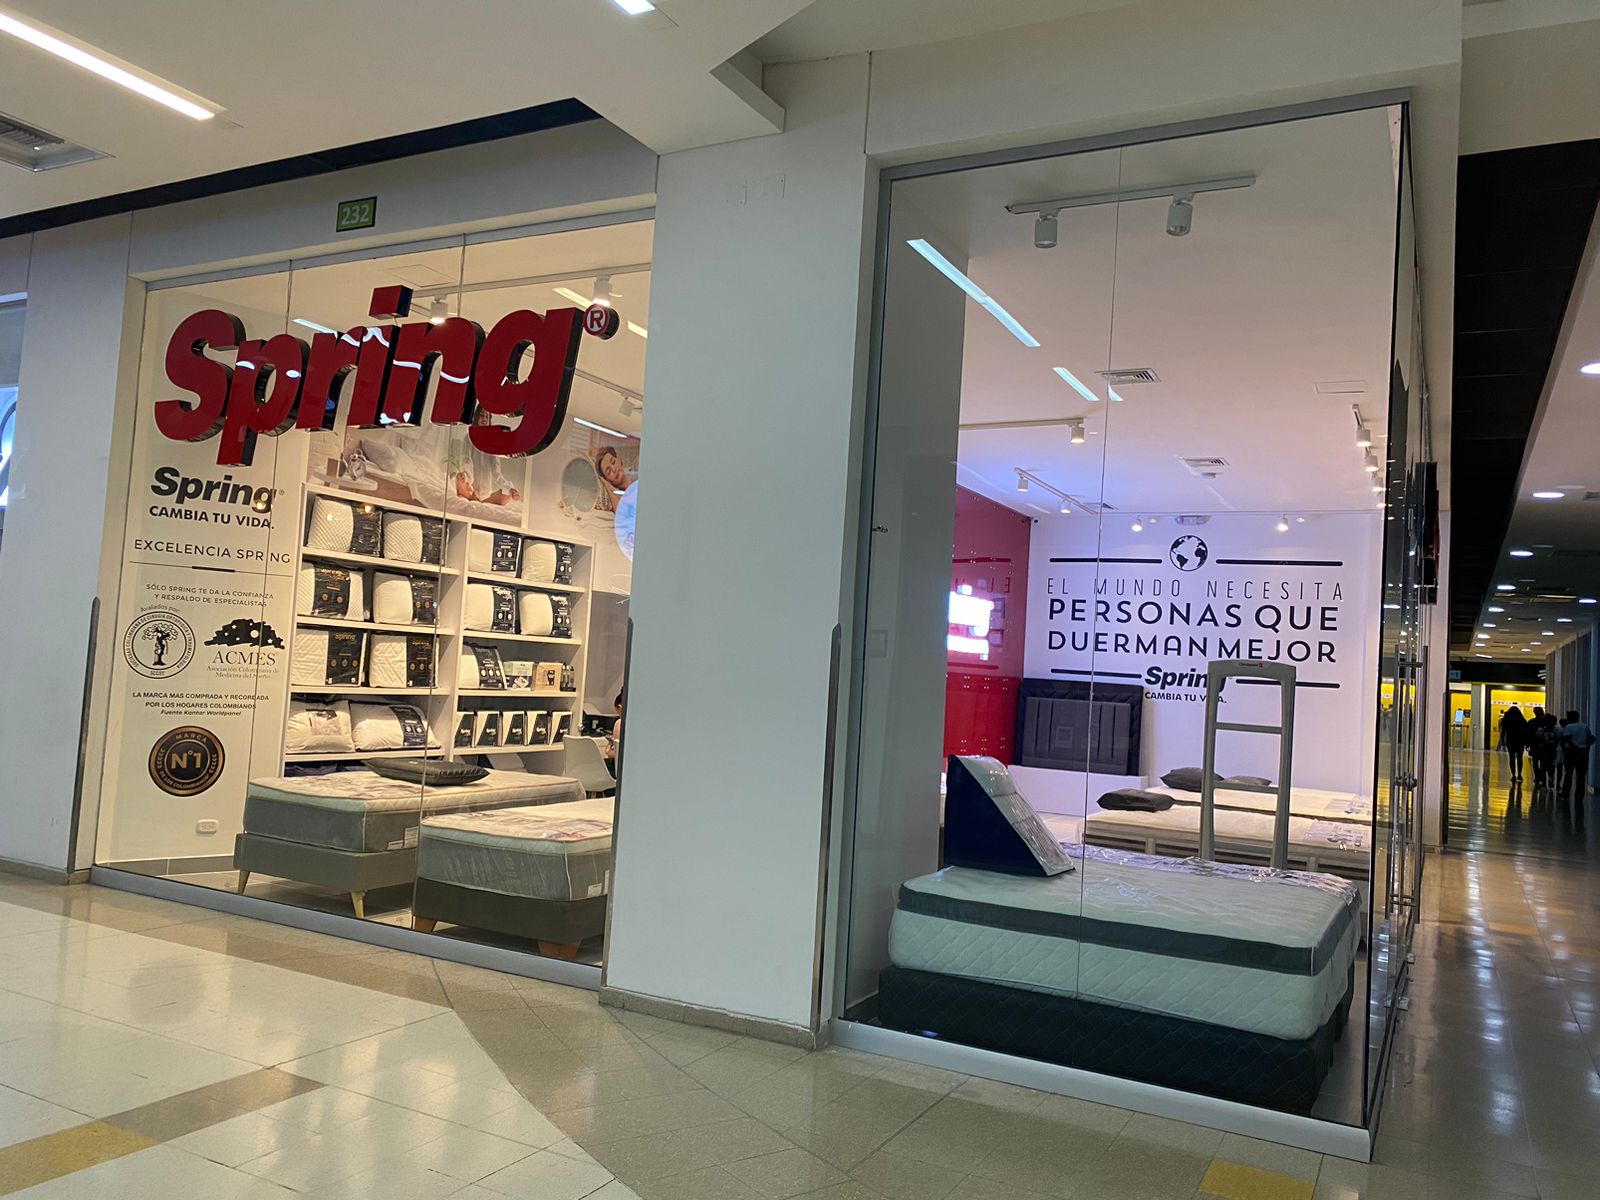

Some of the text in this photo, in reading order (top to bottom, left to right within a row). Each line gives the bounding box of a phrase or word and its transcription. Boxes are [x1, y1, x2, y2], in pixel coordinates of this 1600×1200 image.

[341, 204, 369, 225] 232
[151, 467, 276, 513] Spring
[149, 505, 274, 529] CAMBIA TU VIDA.
[134, 539, 290, 563] EXCELENCIA SPRNG
[169, 585, 197, 594] SPRING
[232, 590, 274, 600] CONFIANZA
[1047, 577, 1343, 601] EL MUNDO NECESITA
[161, 594, 201, 602] RESPALDO
[214, 597, 267, 608] ESPECIALISTAS
[1049, 598, 1339, 634] PERSONAS QUE
[1048, 630, 1336, 663] DUERMAN MEJOR
[212, 651, 276, 666] ACMES
[1144, 691, 1182, 701] CAMBIA
[1199, 694, 1227, 704] VA.
[175, 732, 207, 743] MARCA
